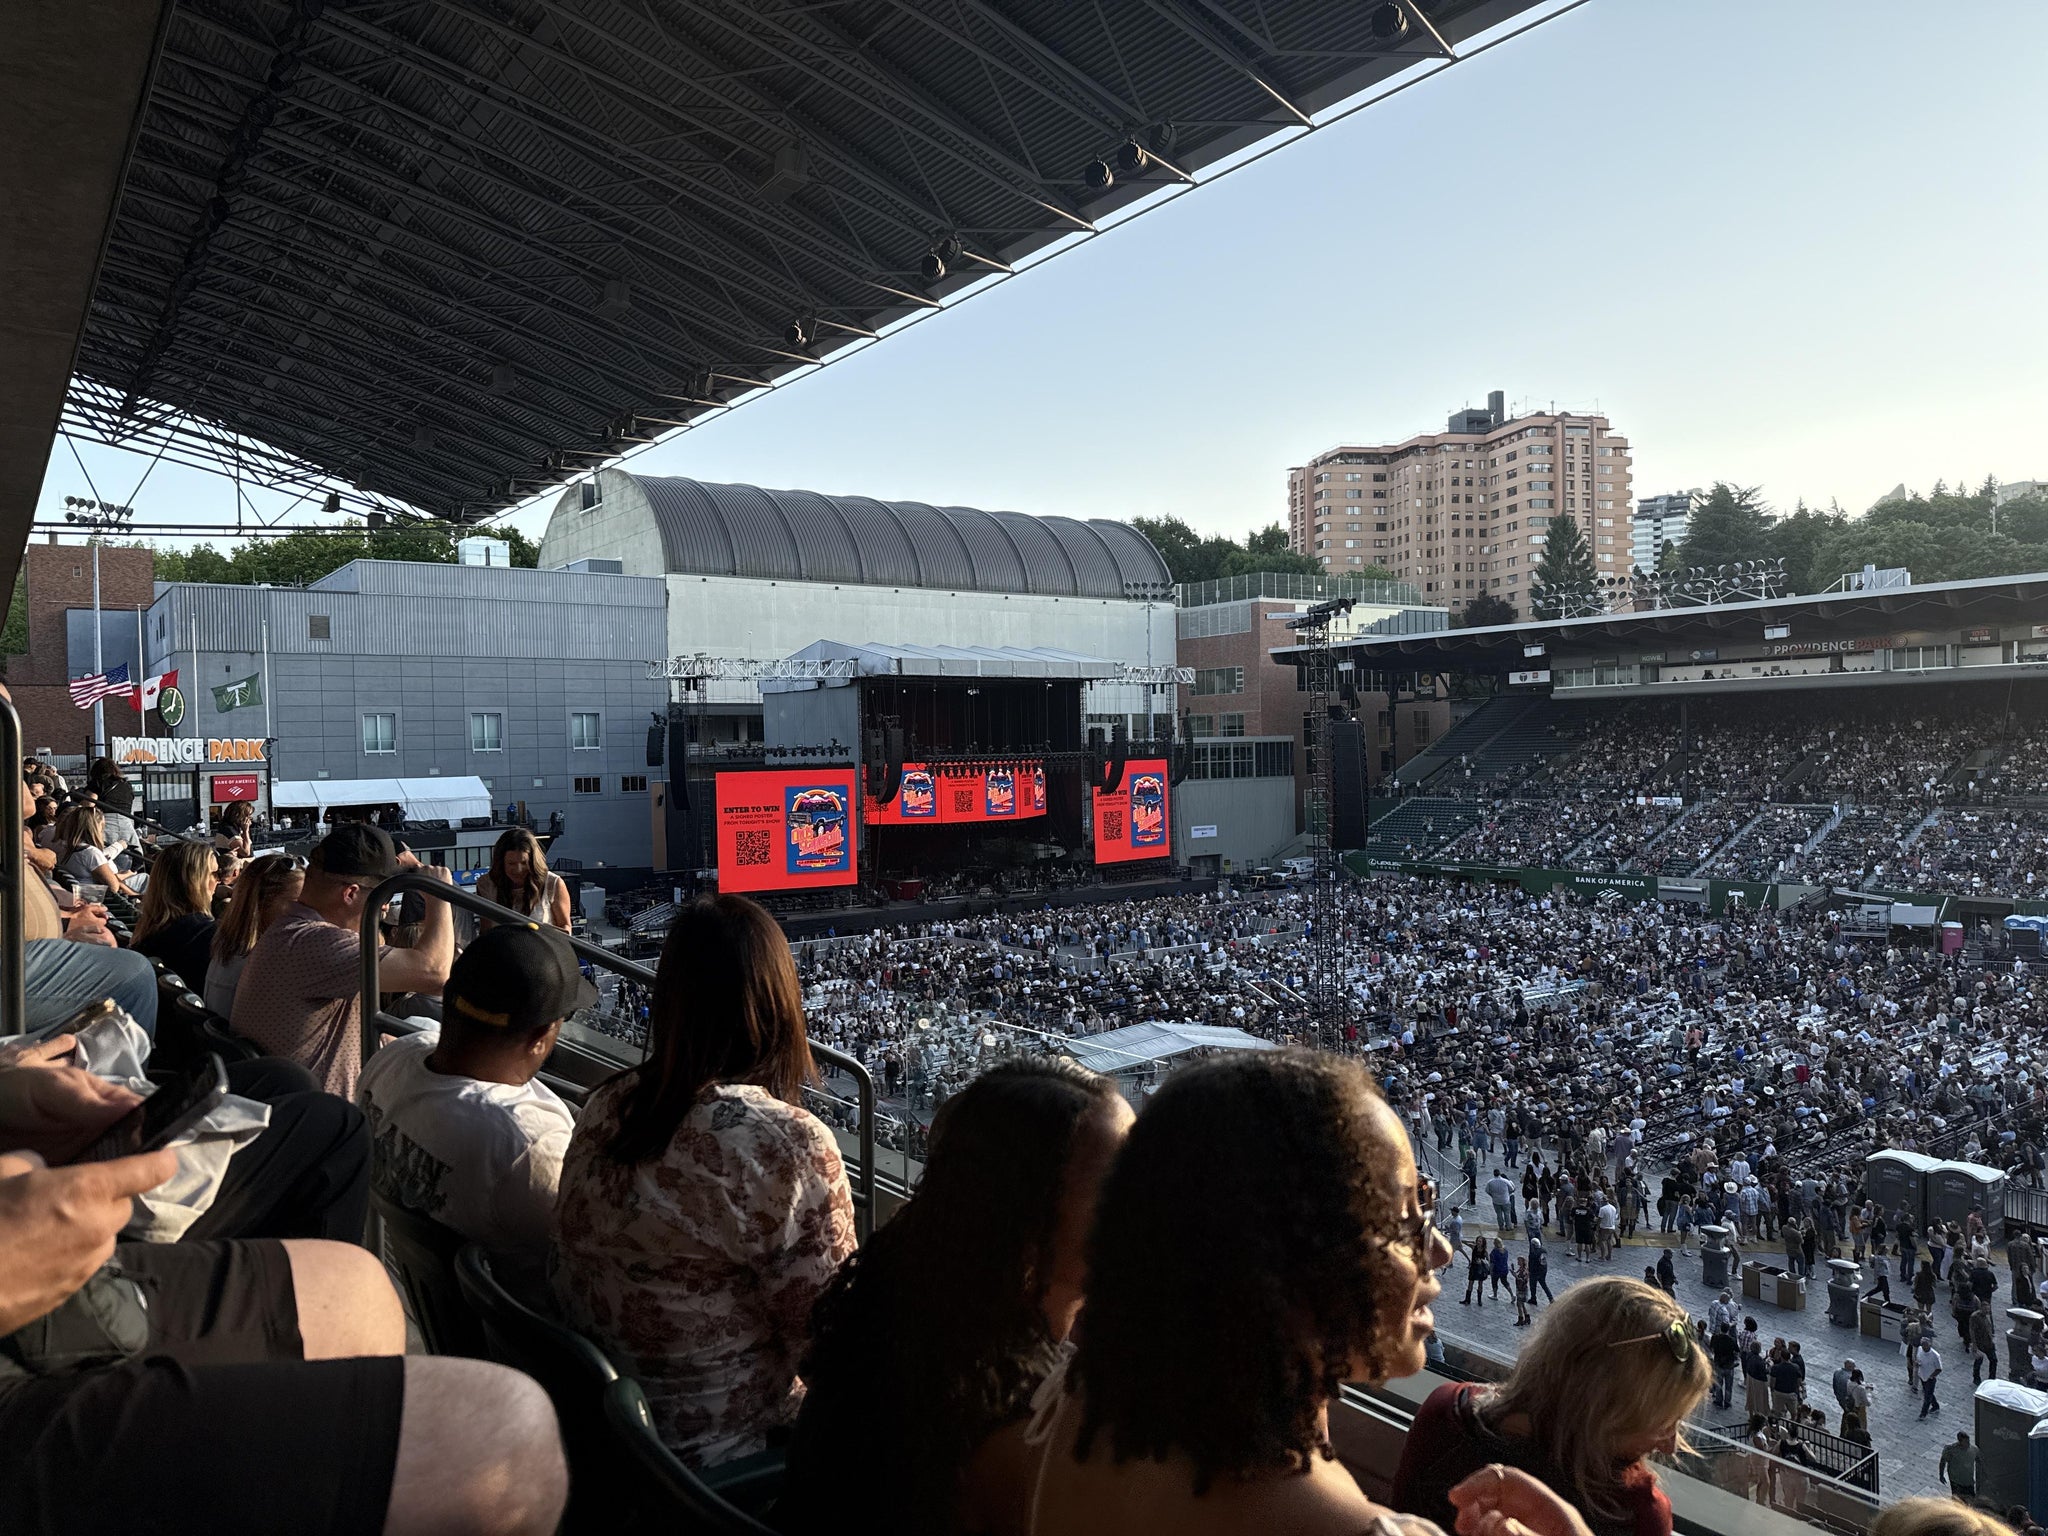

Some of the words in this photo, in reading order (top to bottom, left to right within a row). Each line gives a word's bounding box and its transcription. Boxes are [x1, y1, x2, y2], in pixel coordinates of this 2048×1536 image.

[1774, 641, 1854, 655] PROVIDENCE
[1855, 638, 1892, 650] PARK
[112, 737, 203, 764] PROVIDENCE
[208, 738, 266, 763] PARK
[1576, 876, 1596, 884] BANK
[1609, 879, 1646, 887] AMERICA
